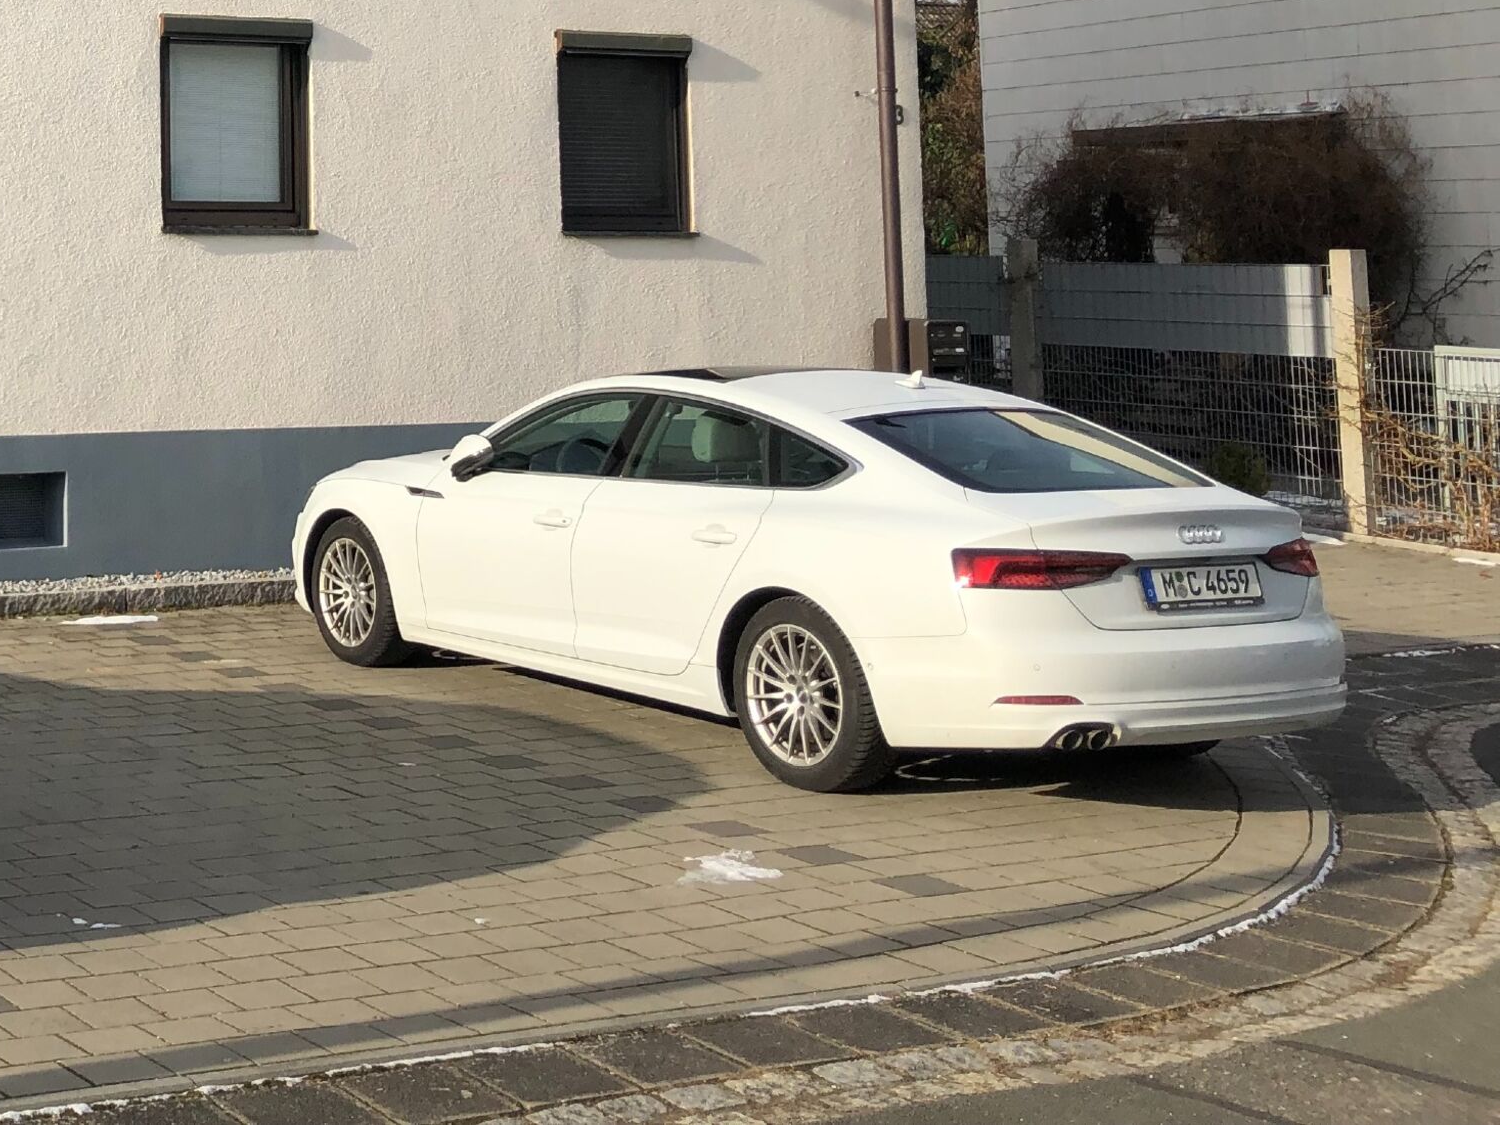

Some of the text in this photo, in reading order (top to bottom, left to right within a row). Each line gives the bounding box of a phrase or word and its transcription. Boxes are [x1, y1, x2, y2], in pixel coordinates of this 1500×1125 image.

[1160, 569, 1249, 597] M C 4659
